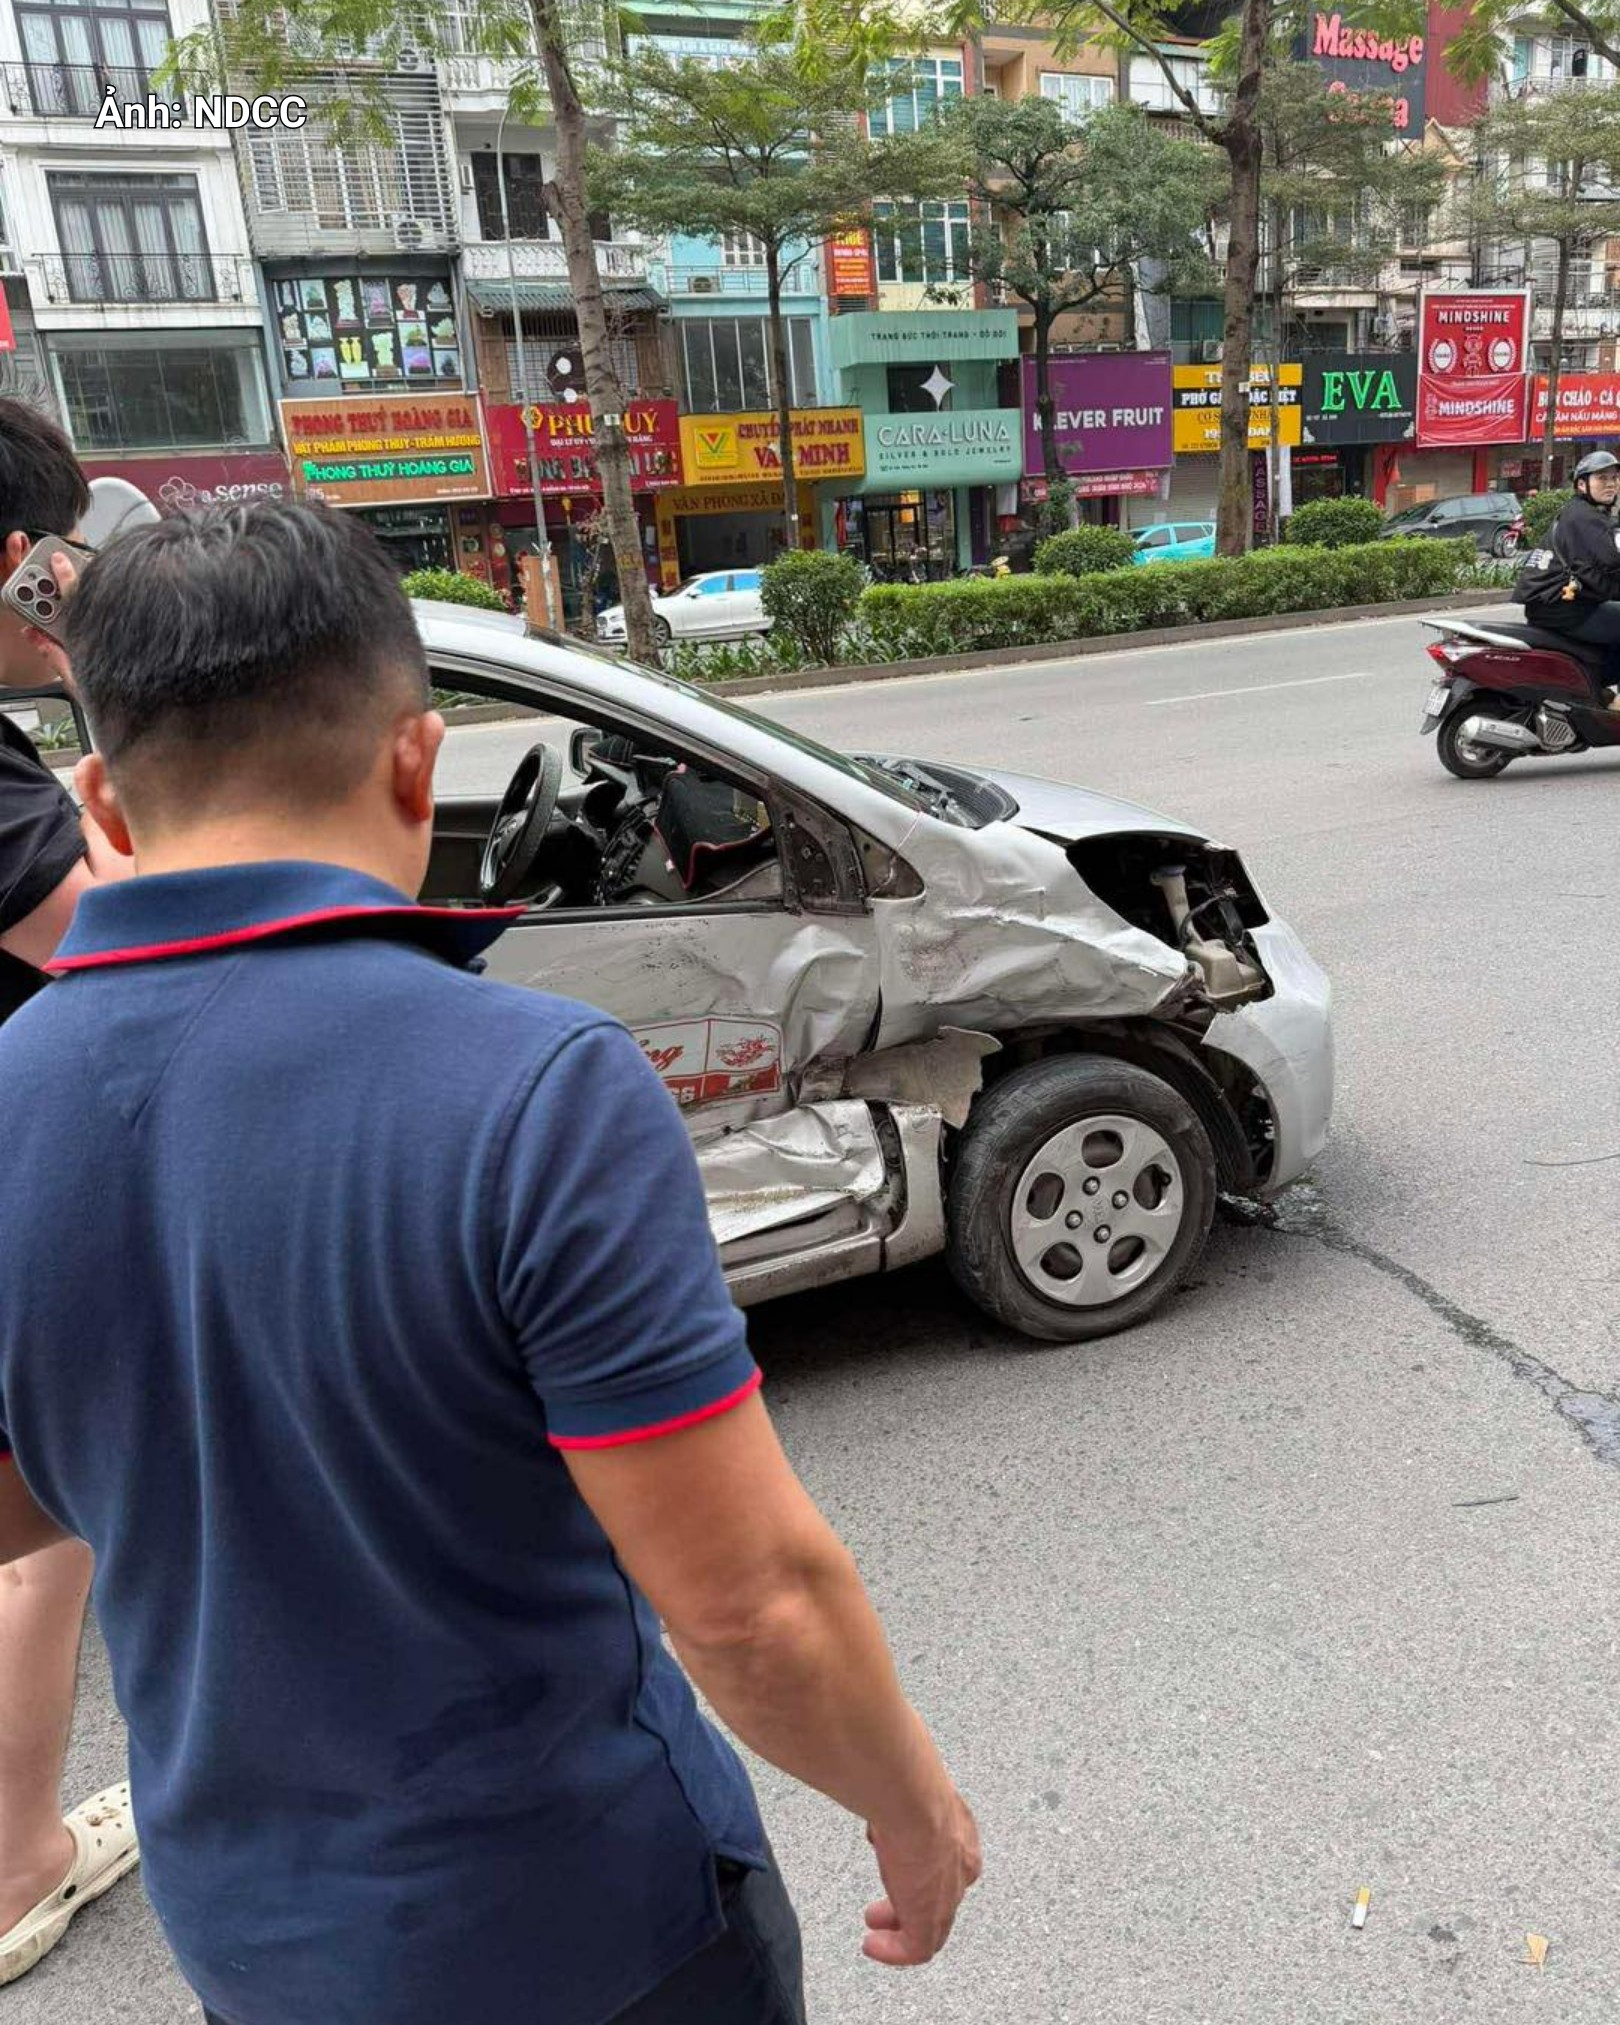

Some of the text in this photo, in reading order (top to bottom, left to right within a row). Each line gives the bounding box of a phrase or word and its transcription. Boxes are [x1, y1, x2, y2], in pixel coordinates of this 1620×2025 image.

[1312, 12, 1424, 72] Massage
[1438, 310, 1510, 324] MINDSHINE
[1181, 387, 1207, 406] PHỞ
[1321, 370, 1402, 411] EVA
[1562, 384, 1592, 407] CHÁO
[1599, 385, 1614, 406] CÁ
[1112, 407, 1164, 427] FRUIT
[1438, 399, 1515, 416] MINDSHINE
[818, 417, 859, 435] NHANH
[797, 442, 850, 467] MINH
[879, 450, 916, 460] SILVER
[966, 445, 1011, 456] JEWELRY
[302, 460, 356, 481] PHONG
[449, 458, 474, 472] GIA
